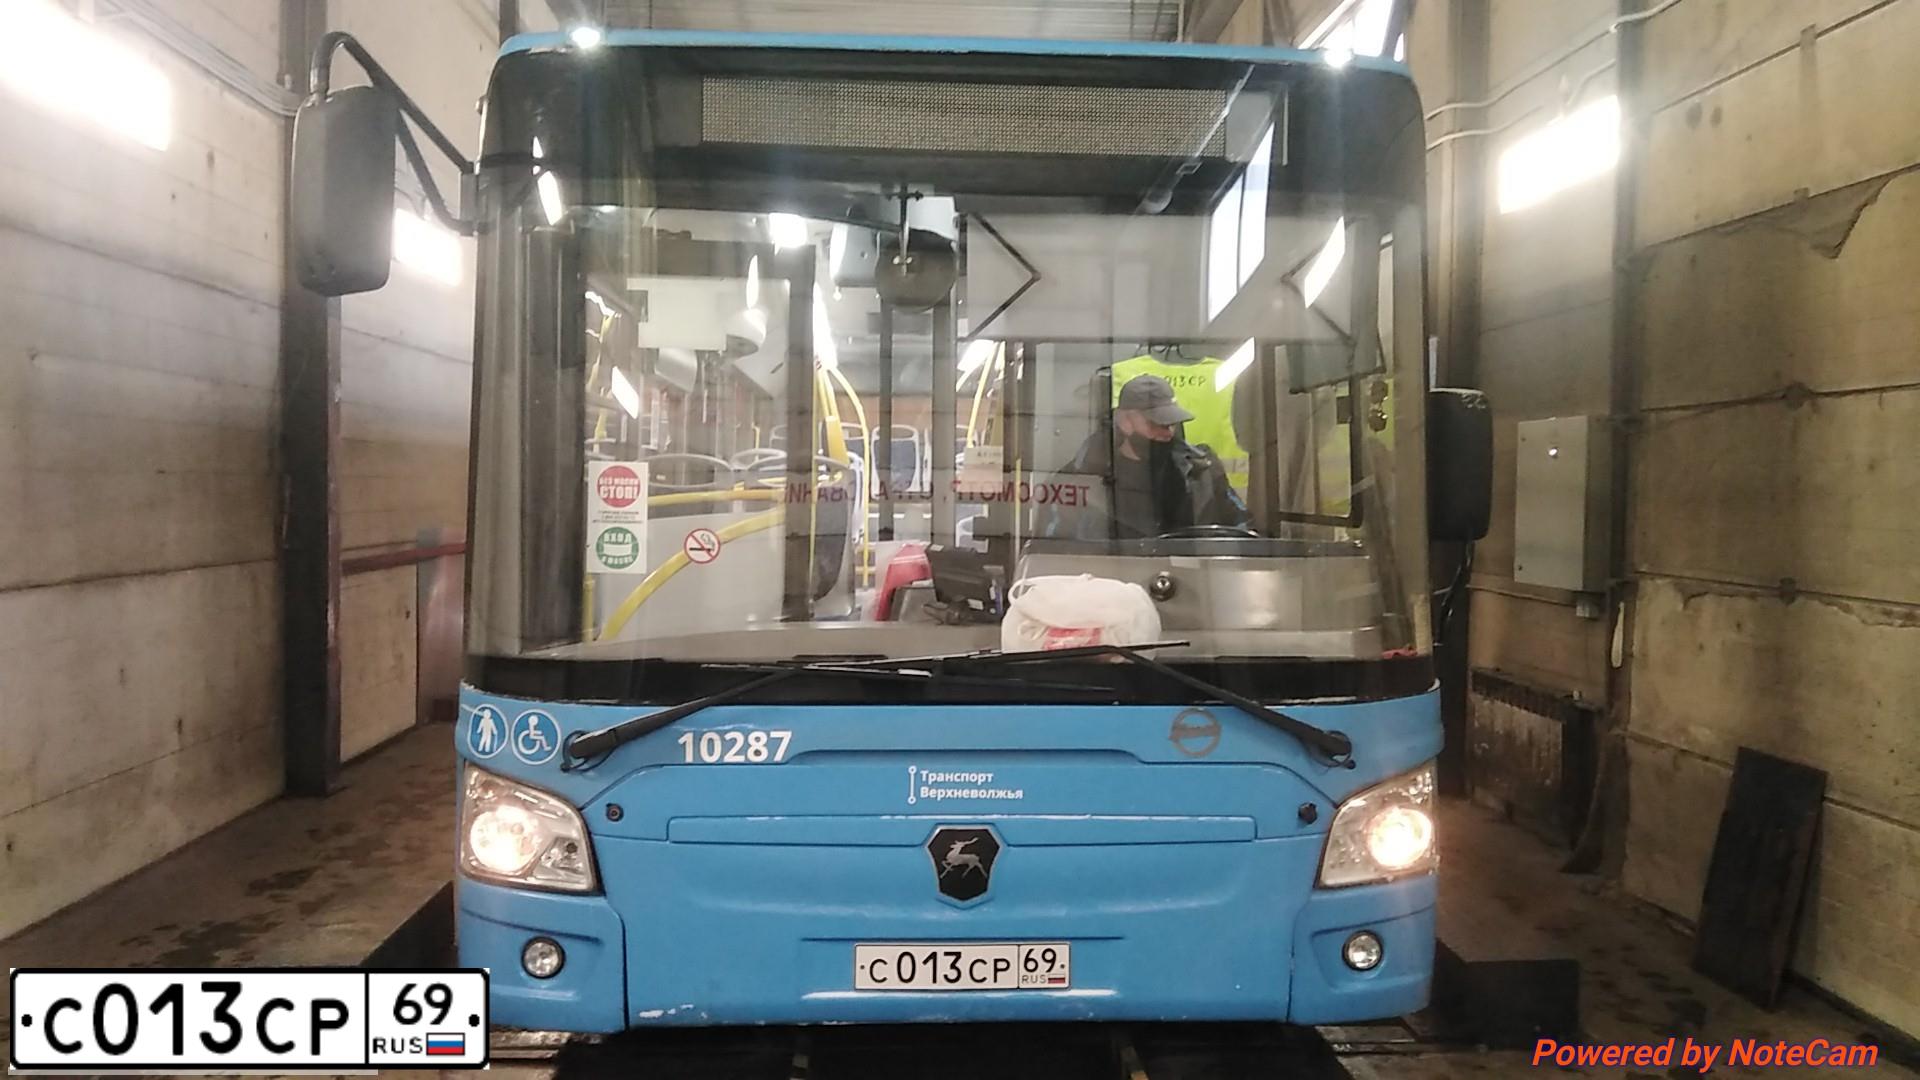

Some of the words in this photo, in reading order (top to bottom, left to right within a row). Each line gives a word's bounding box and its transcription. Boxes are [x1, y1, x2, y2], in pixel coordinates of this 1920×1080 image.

[600, 485, 638, 499] СТОП!
[678, 731, 792, 763] 10287
[920, 769, 994, 784] Транспорт
[920, 786, 1023, 800] Верхневолжья
[869, 951, 1011, 984] С013СР
[1023, 948, 1057, 973] 69
[1022, 974, 1047, 984] RUS
